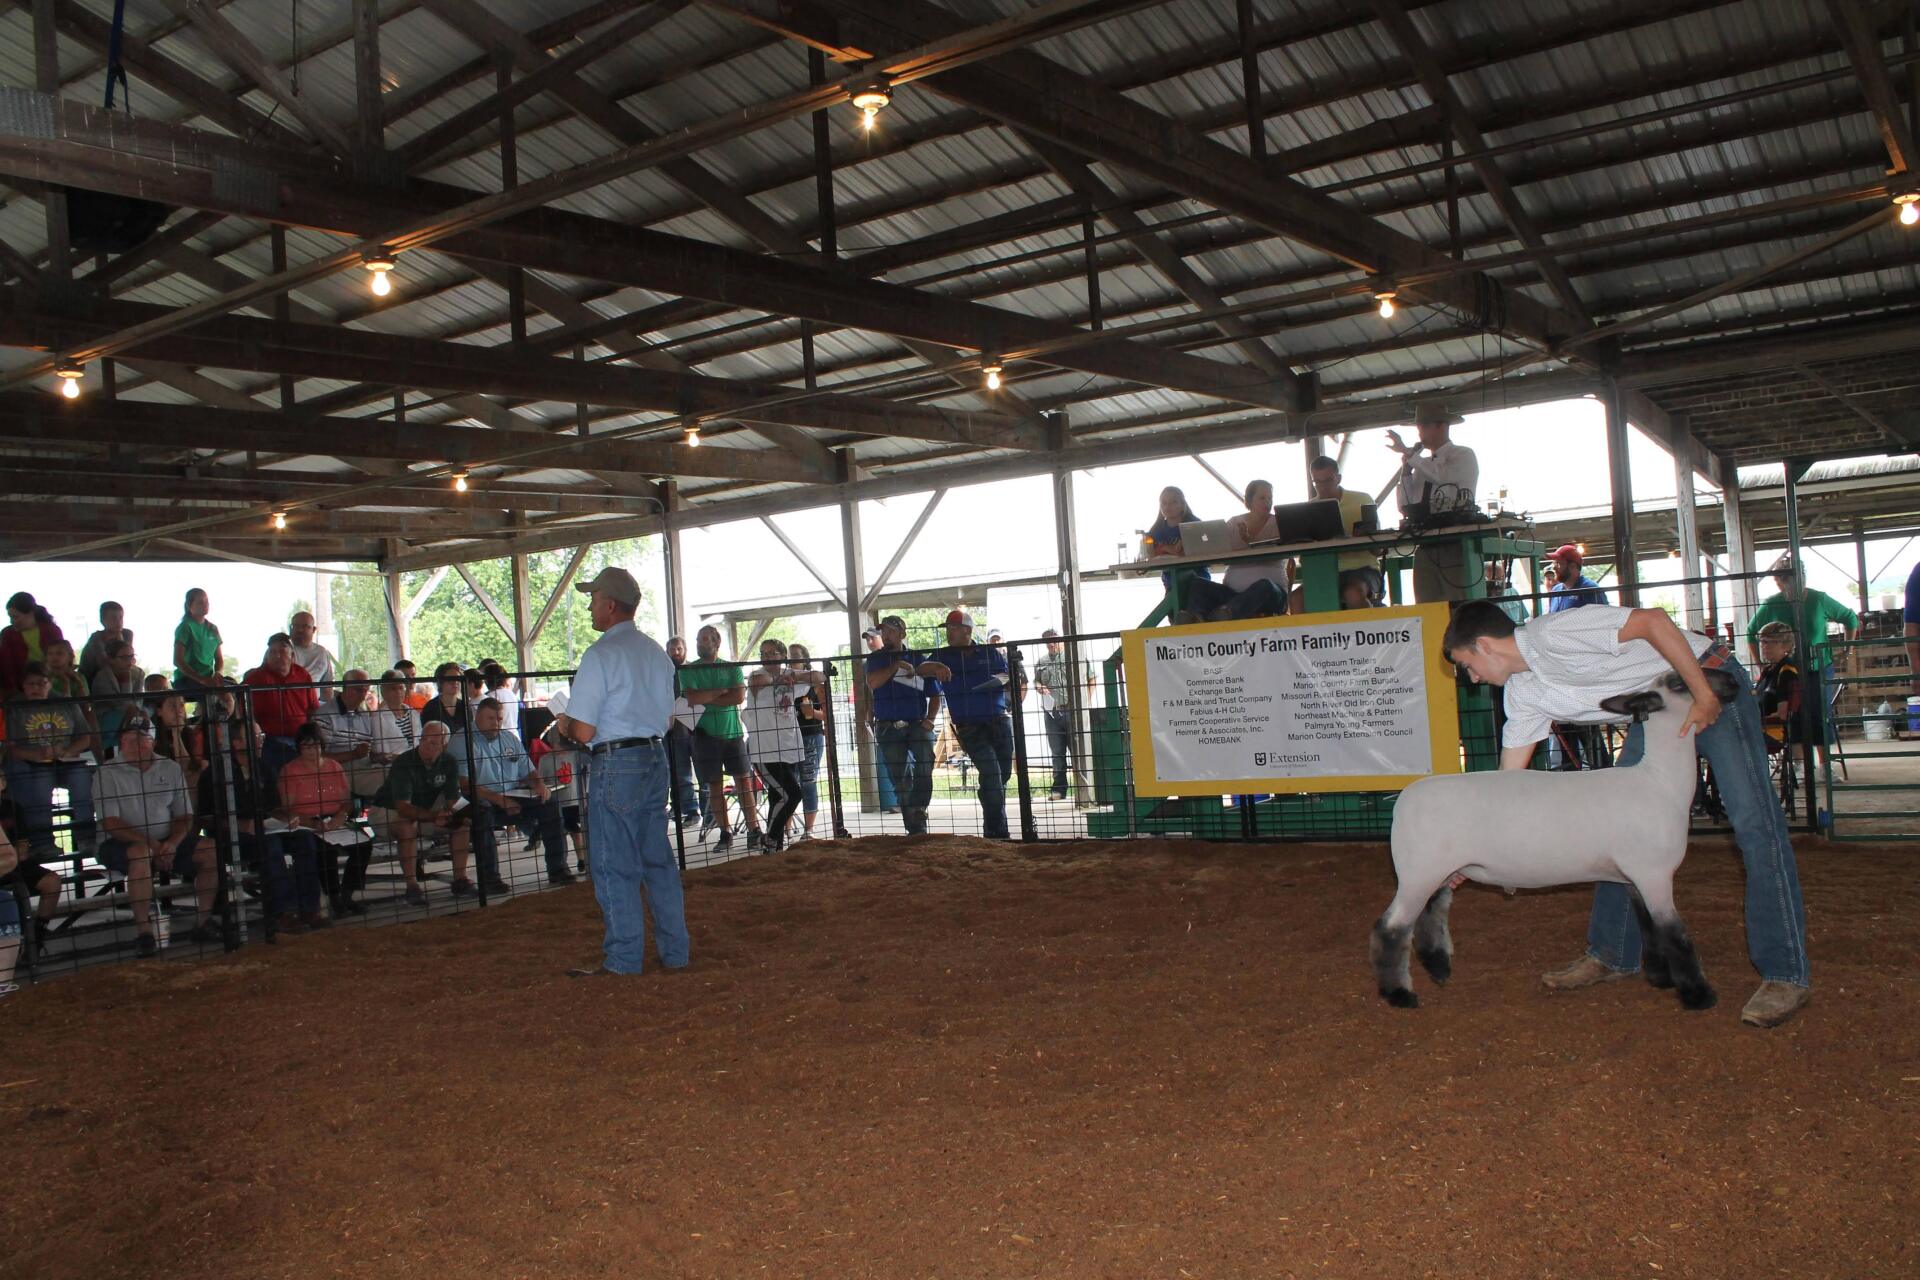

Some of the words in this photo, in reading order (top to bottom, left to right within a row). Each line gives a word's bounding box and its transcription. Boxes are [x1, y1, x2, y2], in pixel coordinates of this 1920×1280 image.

[1156, 645, 1203, 661] Marion
[1208, 641, 1255, 657] County
[1261, 637, 1297, 653] Farm
[1302, 633, 1350, 651] Family
[1356, 629, 1410, 646] Donors
[1312, 660, 1347, 669] Krigbaum
[1296, 670, 1350, 679] Macon-Atlanta
[1375, 666, 1395, 674] Bank
[1321, 680, 1347, 688] County
[1350, 678, 1369, 686] Farm
[1372, 677, 1399, 685] Bureau
[1189, 688, 1222, 696] Exchange
[1336, 689, 1364, 697] Electric
[1367, 686, 1413, 695] Cooperative
[1238, 695, 1272, 703] Company
[1344, 699, 1357, 707] Old
[1360, 698, 1374, 706] Iron
[1190, 708, 1212, 716] Fabius
[1295, 711, 1329, 720] Northeast
[1332, 710, 1364, 718] Machine
[1375, 708, 1402, 716] Pattern
[1199, 717, 1241, 725] Cooperative
[1305, 722, 1334, 731] Palmyra
[1336, 720, 1360, 729] Young
[1362, 719, 1394, 727] Farmers
[1176, 728, 1200, 736] Heimer
[1288, 733, 1314, 741] Marion
[1316, 732, 1342, 741] County
[1344, 730, 1381, 738] Extension
[1384, 728, 1412, 736] Council
[1270, 752, 1320, 763] Extension
